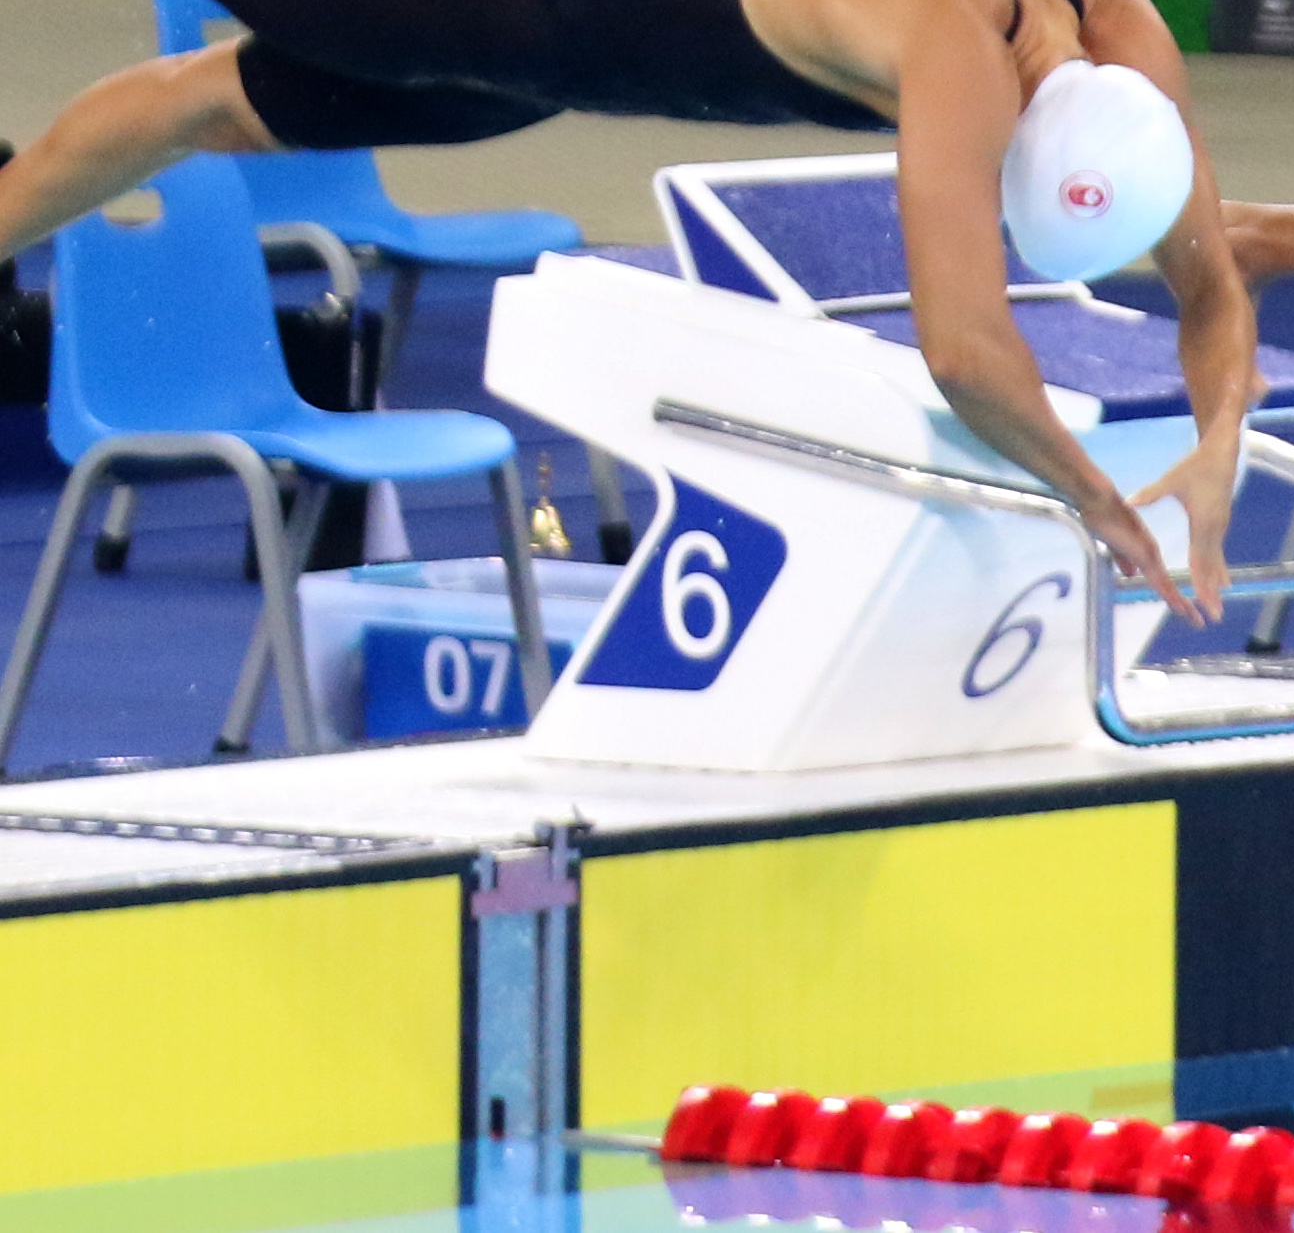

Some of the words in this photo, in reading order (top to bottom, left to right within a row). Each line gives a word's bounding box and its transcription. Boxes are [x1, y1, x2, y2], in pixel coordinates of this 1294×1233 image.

[661, 529, 732, 661] 6
[960, 570, 1073, 699] 6
[423, 634, 514, 715] 07
